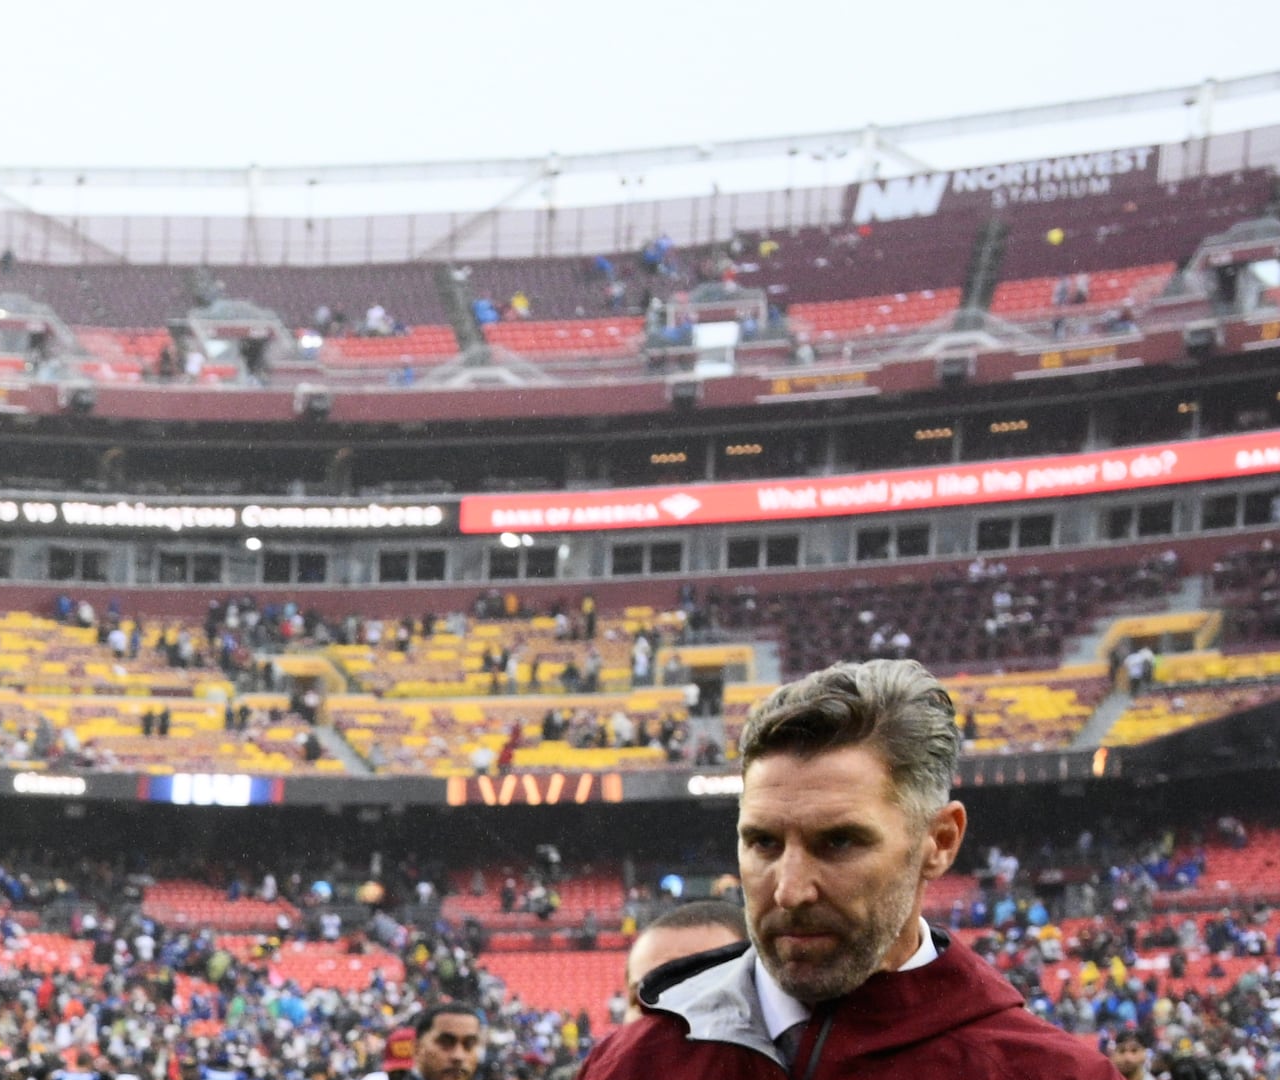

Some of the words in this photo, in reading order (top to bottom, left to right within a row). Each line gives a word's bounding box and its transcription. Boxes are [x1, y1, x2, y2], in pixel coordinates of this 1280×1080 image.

[952, 146, 1152, 193] NORTHWEST
[991, 175, 1112, 208] STADIUM
[757, 486, 817, 511] What
[820, 479, 888, 506] would
[890, 481, 934, 507] you
[937, 471, 979, 497] like
[982, 467, 1023, 493] the
[1025, 464, 1100, 493] power
[1101, 458, 1127, 482] to
[1129, 449, 1178, 479] do?
[22, 501, 57, 523] vs
[61, 501, 236, 532] Washington
[492, 508, 543, 527] BANK
[544, 507, 571, 526] OF
[572, 503, 659, 524] AMERICA
